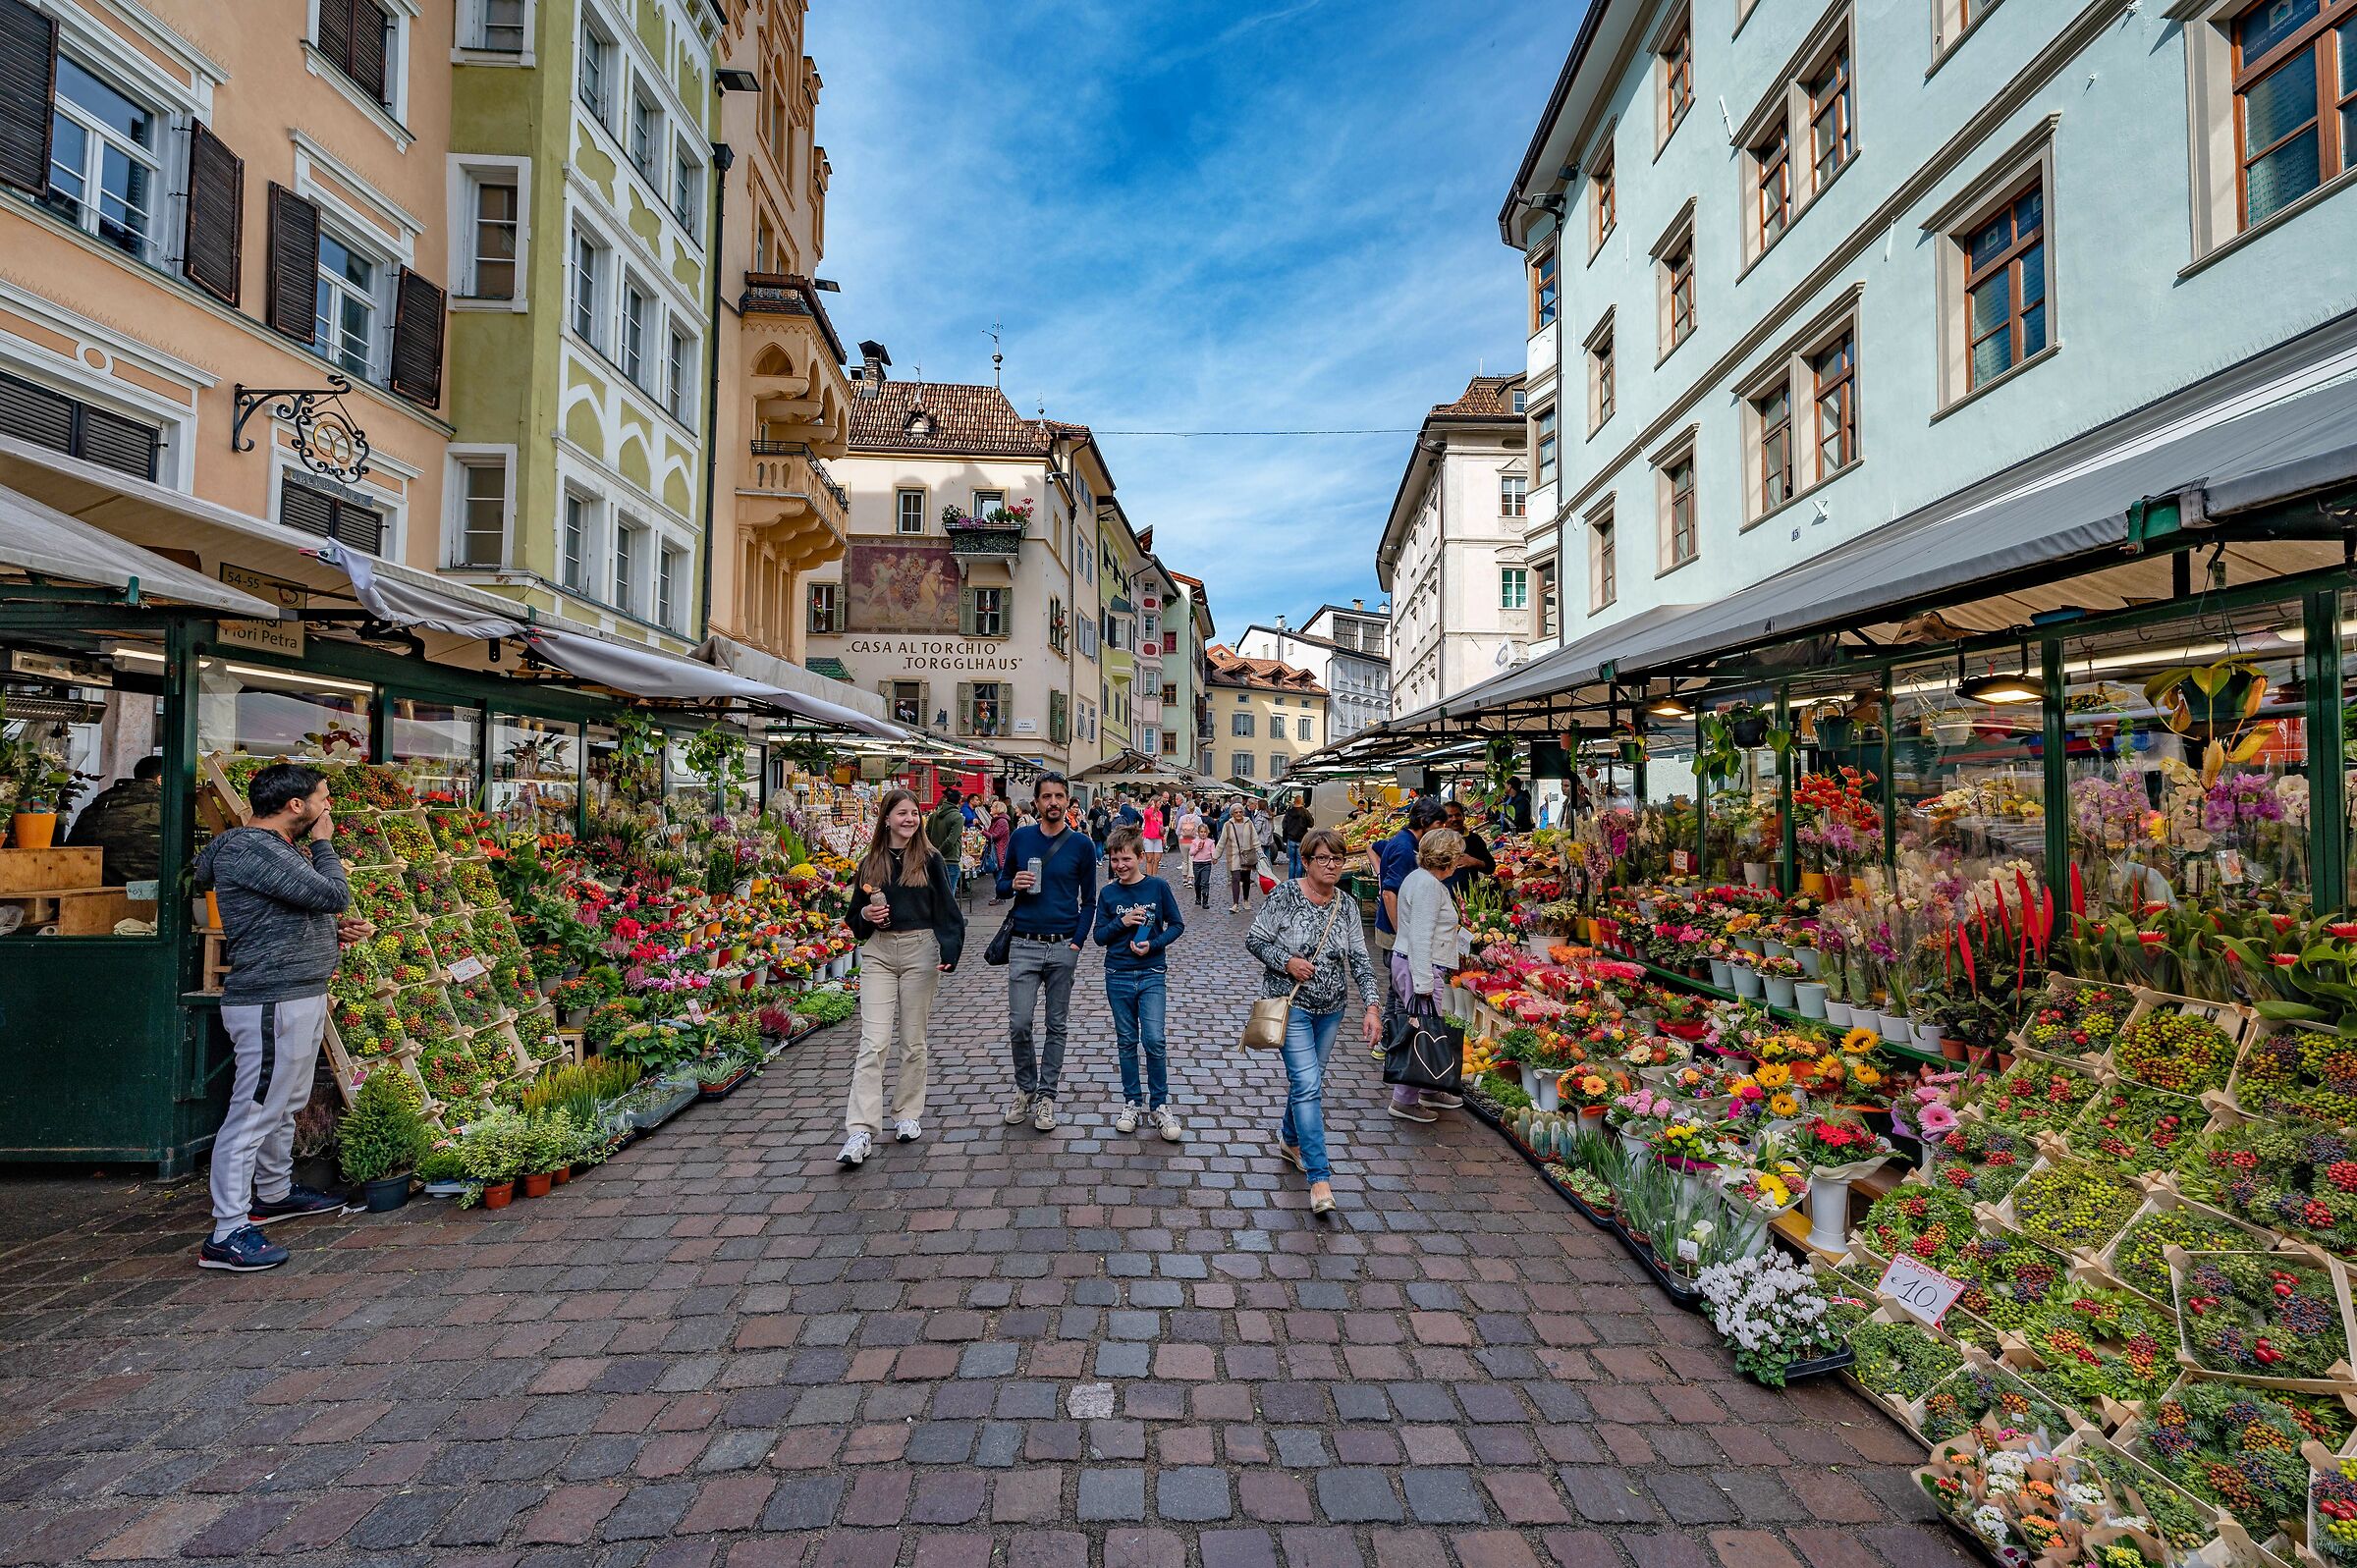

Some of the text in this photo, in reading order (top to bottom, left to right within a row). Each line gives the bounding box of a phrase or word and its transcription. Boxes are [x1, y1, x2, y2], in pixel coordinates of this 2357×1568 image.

[227, 571, 260, 589] 54-55
[224, 627, 298, 648] iori Petra
[898, 641, 917, 654] AL
[1116, 904, 1133, 915] Pepe
[1895, 1256, 1961, 1292] CORONCINE
